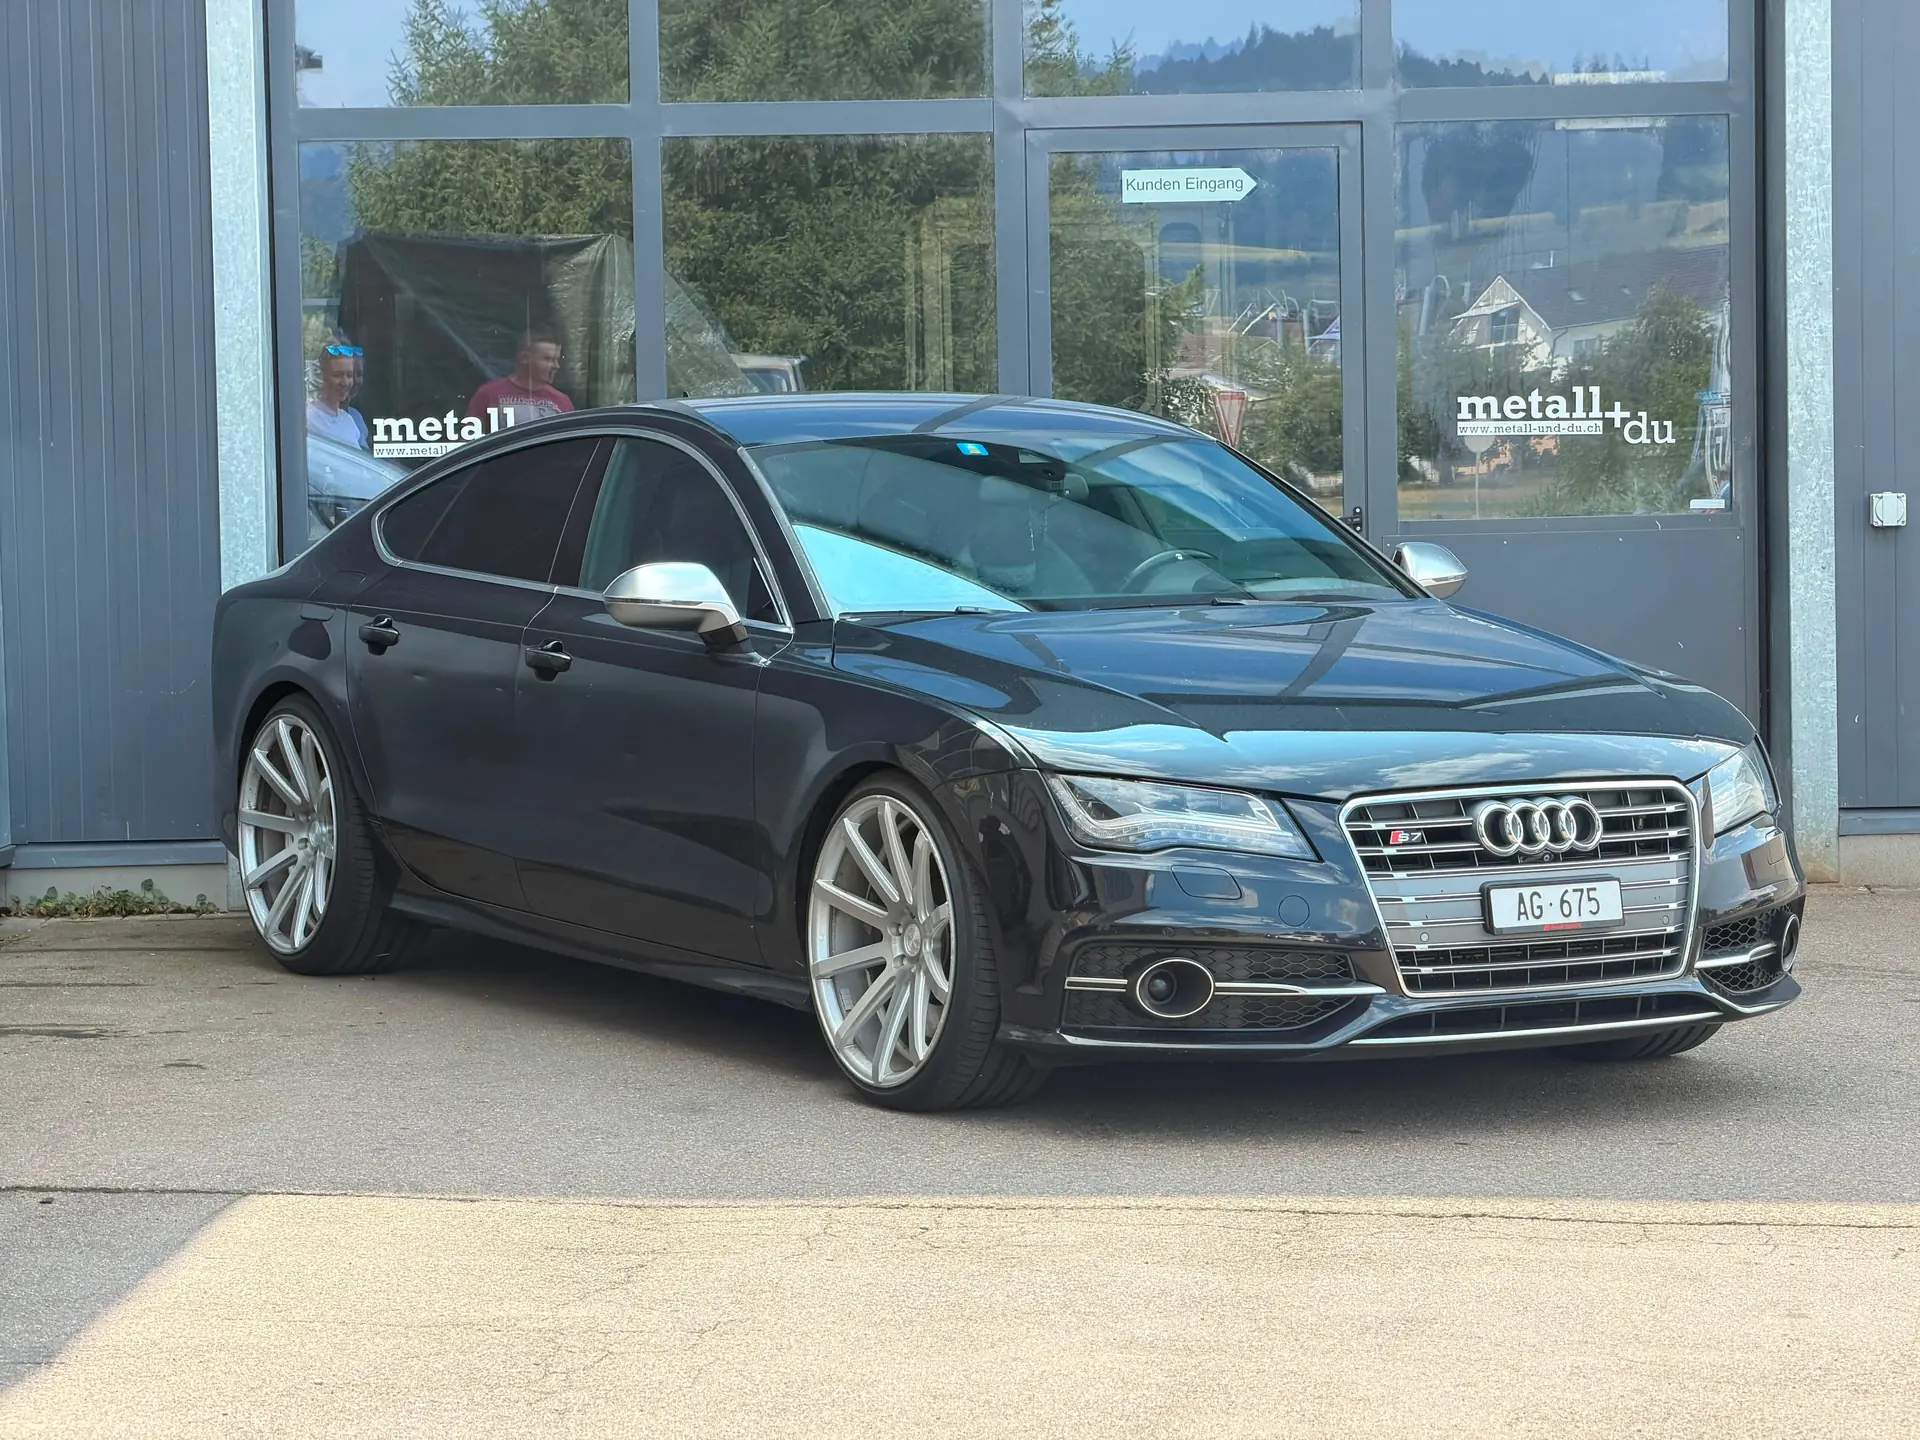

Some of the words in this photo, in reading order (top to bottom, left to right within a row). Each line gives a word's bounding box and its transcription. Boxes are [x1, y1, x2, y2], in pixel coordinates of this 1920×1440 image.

[1126, 178, 1181, 192] Kunden
[1185, 177, 1244, 193] Eingang
[1458, 422, 1602, 434] www.metall-und-du.ch
[1398, 832, 1422, 842] S7
